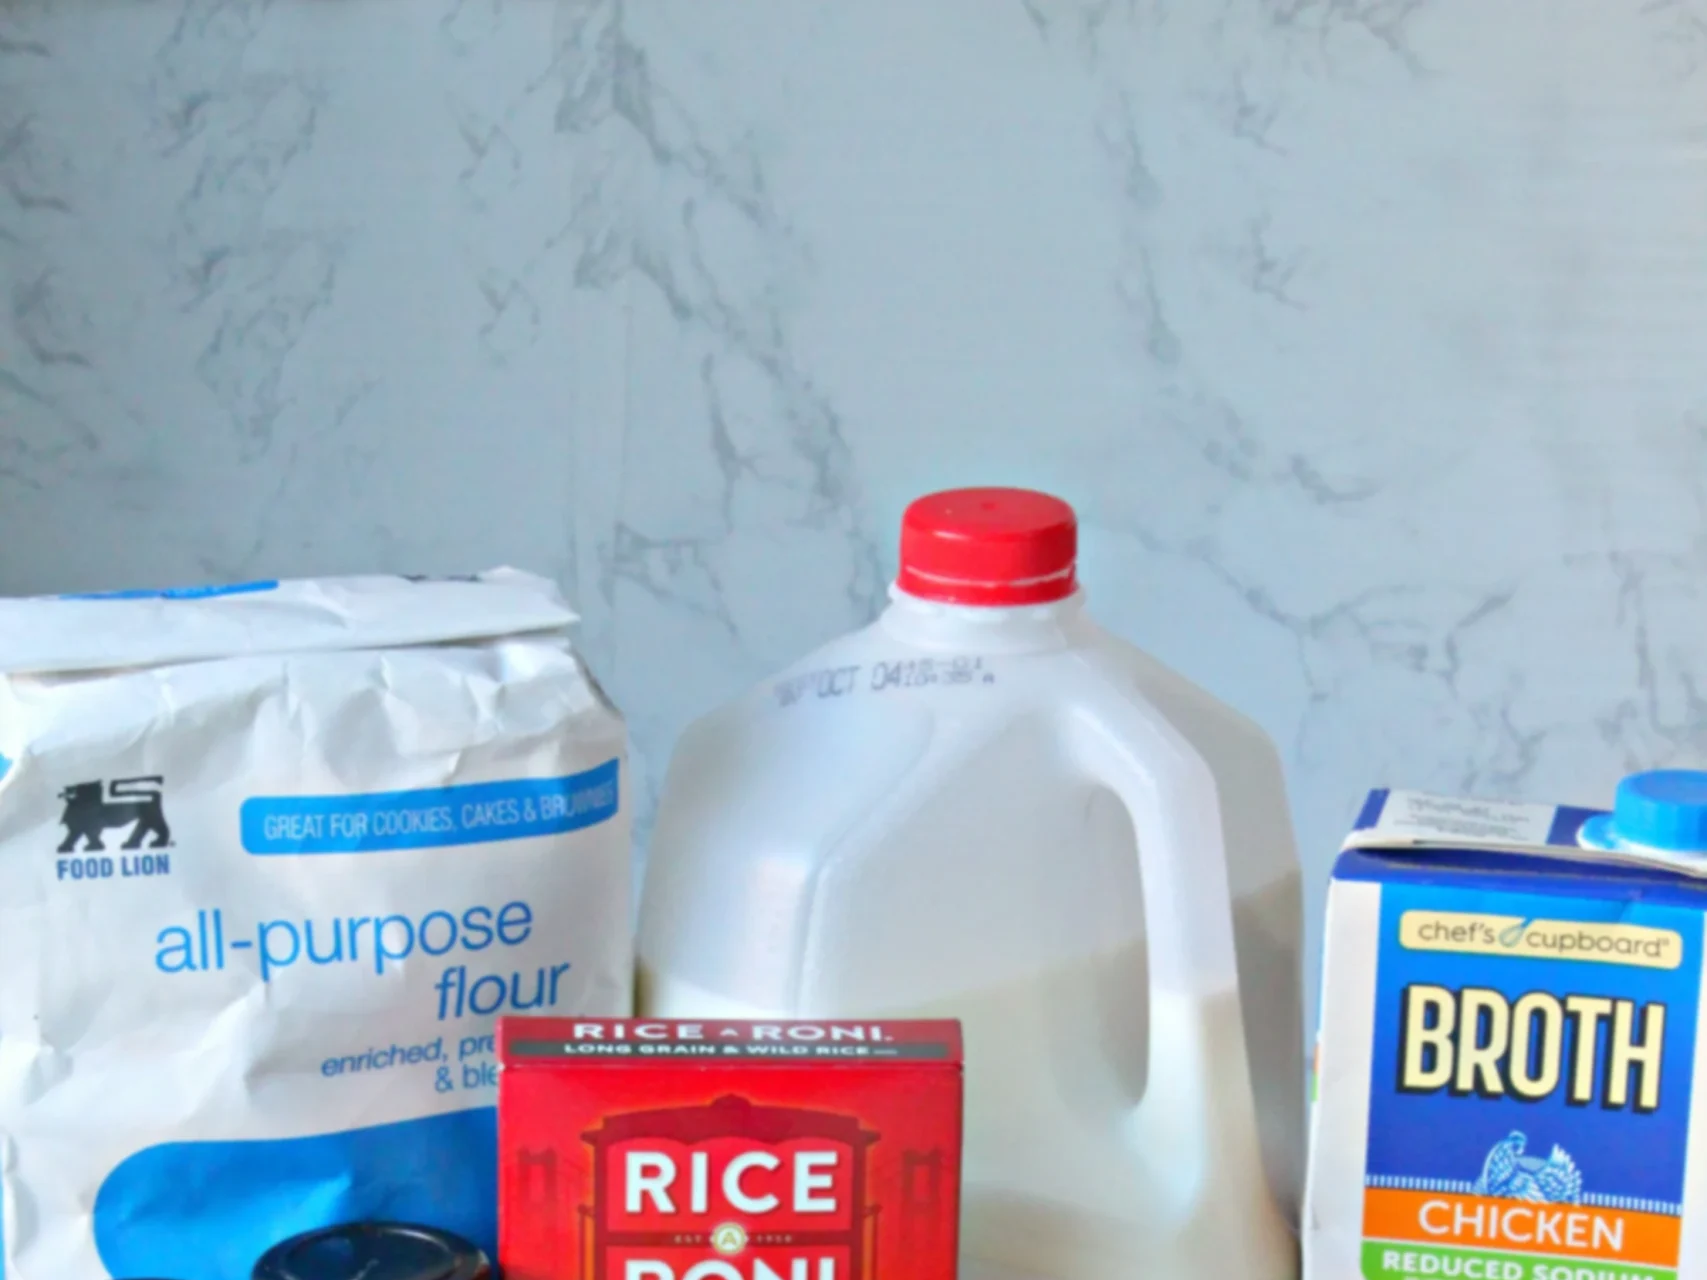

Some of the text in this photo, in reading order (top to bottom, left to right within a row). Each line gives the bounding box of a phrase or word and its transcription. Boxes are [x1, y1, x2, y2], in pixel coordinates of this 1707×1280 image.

[264, 780, 614, 840] GREAT FOR COOKIES, CAKES & BROW
[56, 853, 170, 880] FOOD LION
[156, 901, 532, 982] all-purpose
[1418, 921, 1663, 957] chef's cupboard
[434, 962, 571, 1020] flour
[564, 1043, 632, 1054] LONG
[639, 1043, 715, 1055] GRAIN
[746, 1043, 808, 1055] WILD
[815, 1045, 869, 1056] RICE
[573, 1023, 704, 1040] RICE
[751, 1024, 883, 1042] RONI
[1400, 984, 1668, 1110] BROTH
[321, 1037, 448, 1077] enriched,
[435, 1066, 453, 1093] &
[624, 1150, 838, 1213] RICE
[1418, 1199, 1624, 1252] CHICKEN
